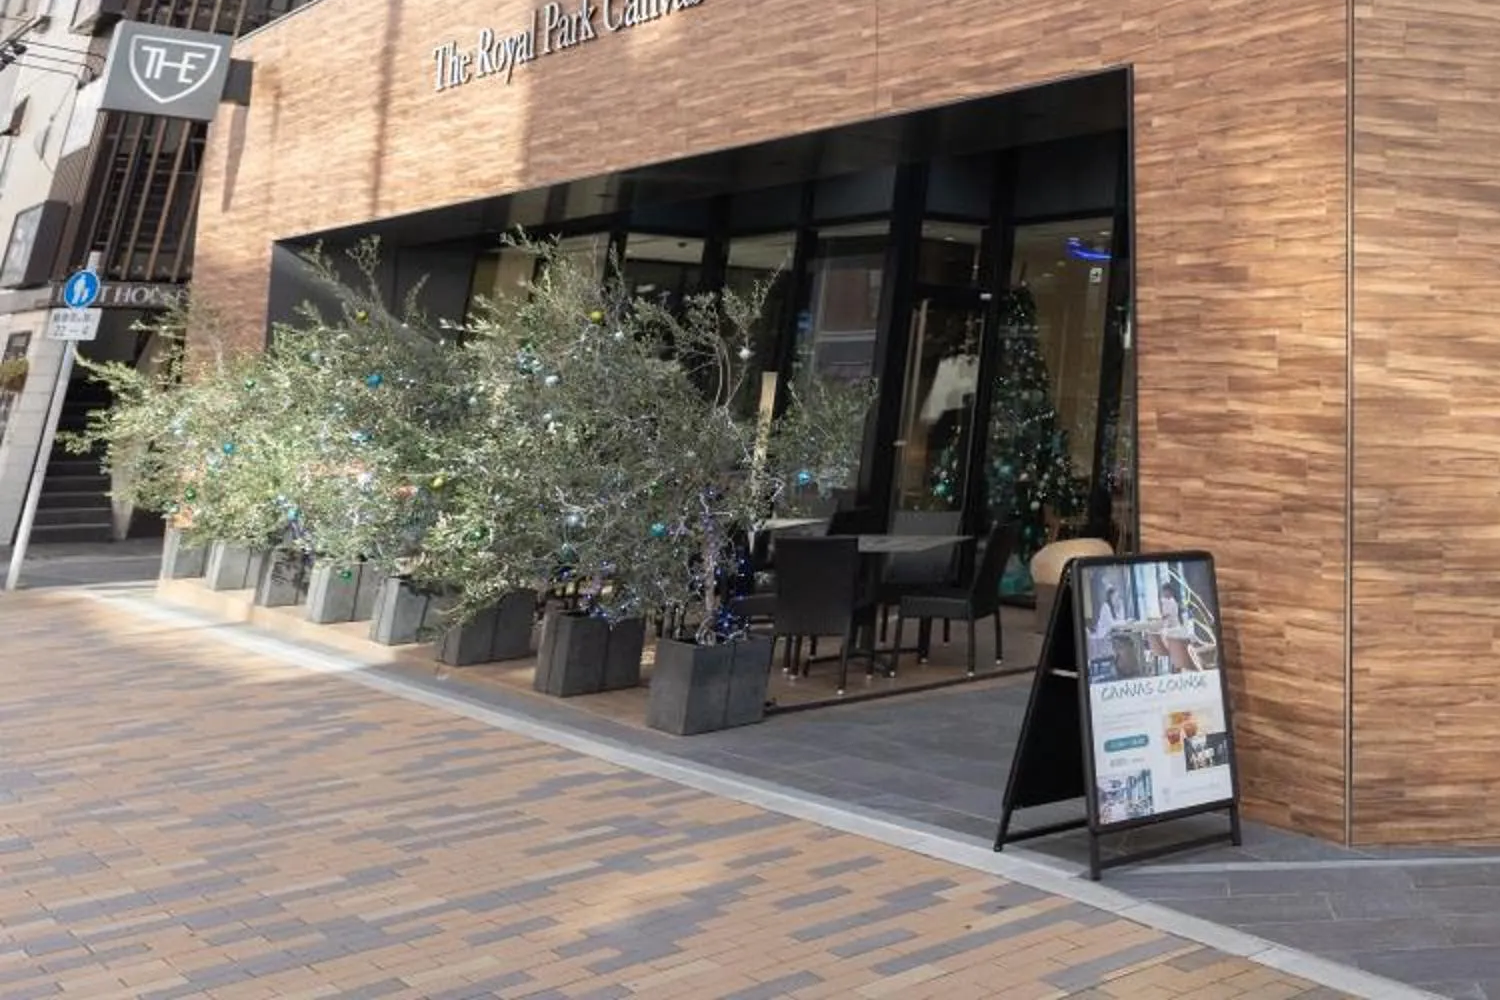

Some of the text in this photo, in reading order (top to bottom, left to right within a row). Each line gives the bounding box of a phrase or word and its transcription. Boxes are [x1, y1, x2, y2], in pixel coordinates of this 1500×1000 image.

[141, 45, 206, 83] THE
[434, 40, 472, 92] The
[476, 8, 537, 85] Royal
[1101, 682, 1153, 701] CANVAS
